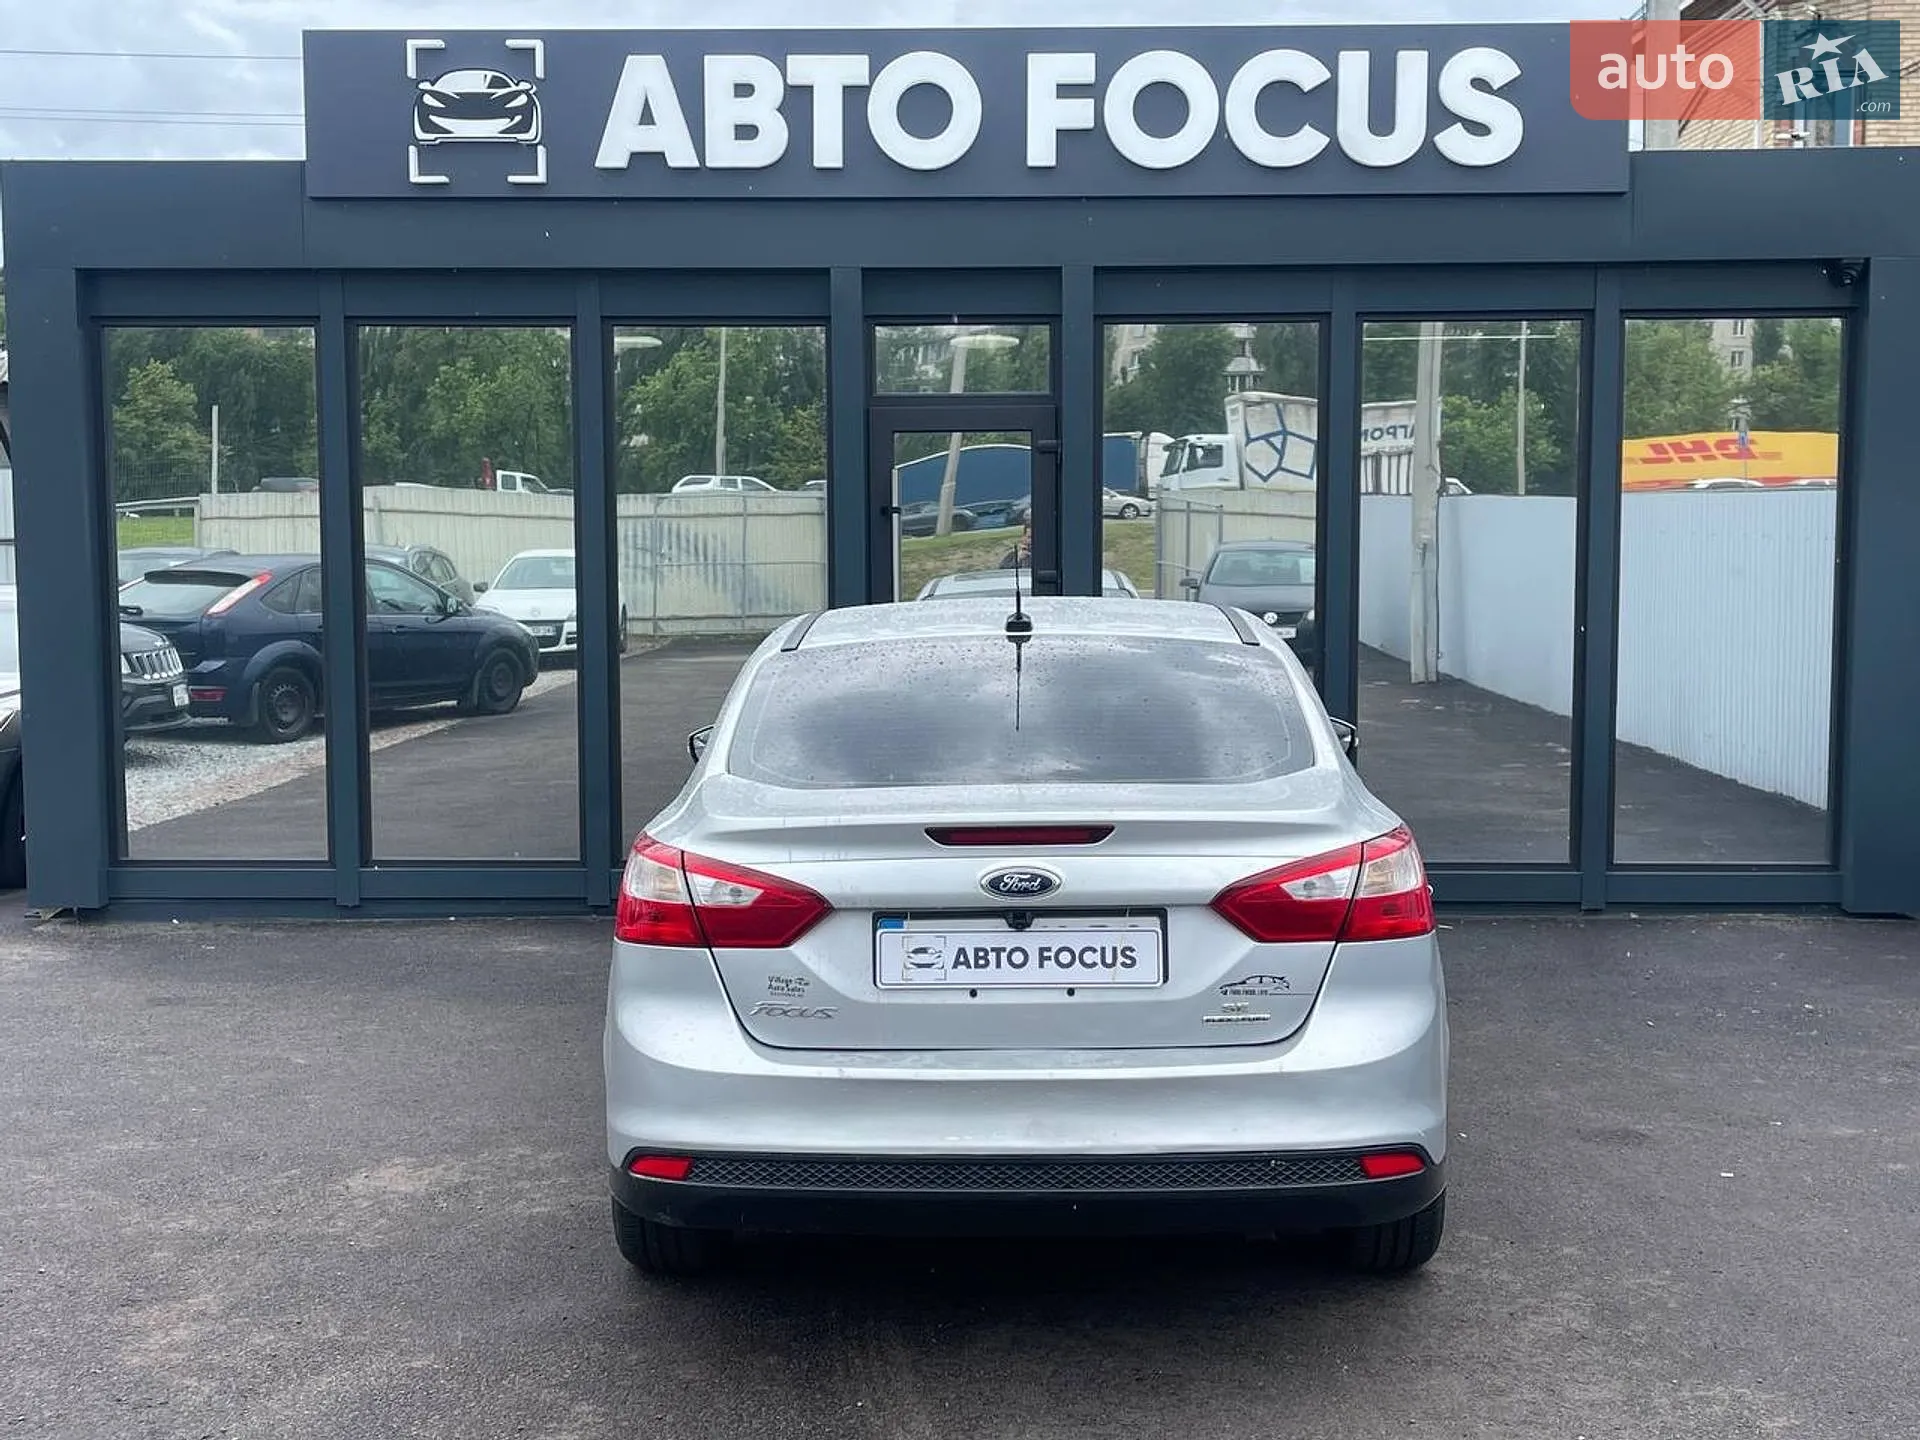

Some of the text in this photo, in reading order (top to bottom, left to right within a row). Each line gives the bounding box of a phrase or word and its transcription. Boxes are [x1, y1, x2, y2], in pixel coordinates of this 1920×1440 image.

[594, 47, 1524, 171] АВТО FOCUS
[1000, 874, 1041, 891] Ford
[951, 946, 1029, 970] АВТО
[1037, 946, 1138, 970] FOCUS
